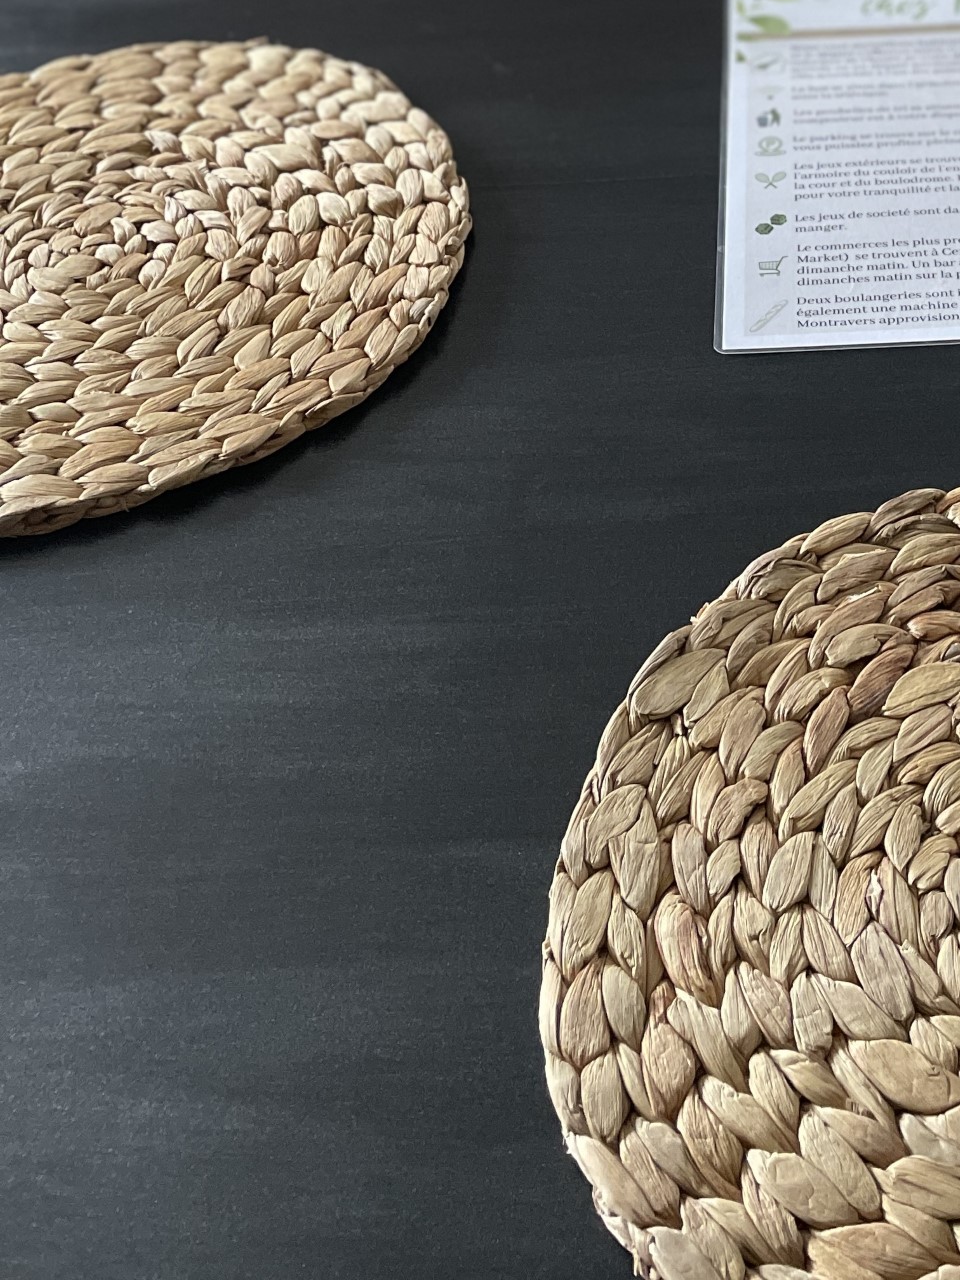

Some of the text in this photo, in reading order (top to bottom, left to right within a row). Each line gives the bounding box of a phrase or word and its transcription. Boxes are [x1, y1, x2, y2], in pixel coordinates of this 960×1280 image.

[792, 161, 814, 170] Les
[816, 160, 842, 171] jeux
[844, 158, 907, 167] extérieurs
[793, 181, 805, 190] la
[839, 180, 851, 188] et
[854, 178, 871, 187] du
[874, 176, 952, 186] boulodrome.
[794, 192, 824, 201] pour
[827, 189, 860, 197] votre
[862, 185, 931, 197] tranquilité
[933, 185, 946, 193] et
[948, 184, 960, 192] la
[794, 214, 815, 222] Les
[817, 212, 844, 223] jeux
[847, 210, 863, 220] de
[866, 208, 910, 219] societé
[913, 208, 940, 217] sont
[794, 224, 848, 234] manger.
[797, 243, 811, 252] Le
[814, 242, 888, 251] commerces
[891, 238, 909, 248] les
[912, 237, 940, 249] plus
[797, 252, 848, 263] Market)
[871, 249, 927, 260] trouvent
[930, 248, 938, 257] à
[796, 263, 863, 274] dimanche
[866, 261, 909, 271] matin.
[911, 260, 930, 269] Un
[933, 259, 955, 268] bar
[796, 274, 870, 286] dimanches
[873, 272, 912, 282] matin
[940, 270, 952, 279] la
[796, 296, 830, 305] Deux
[834, 290, 921, 303] boulangeries
[925, 289, 954, 298] sont
[796, 305, 866, 318] également
[900, 300, 957, 311] machine
[797, 318, 875, 328] Montravers
